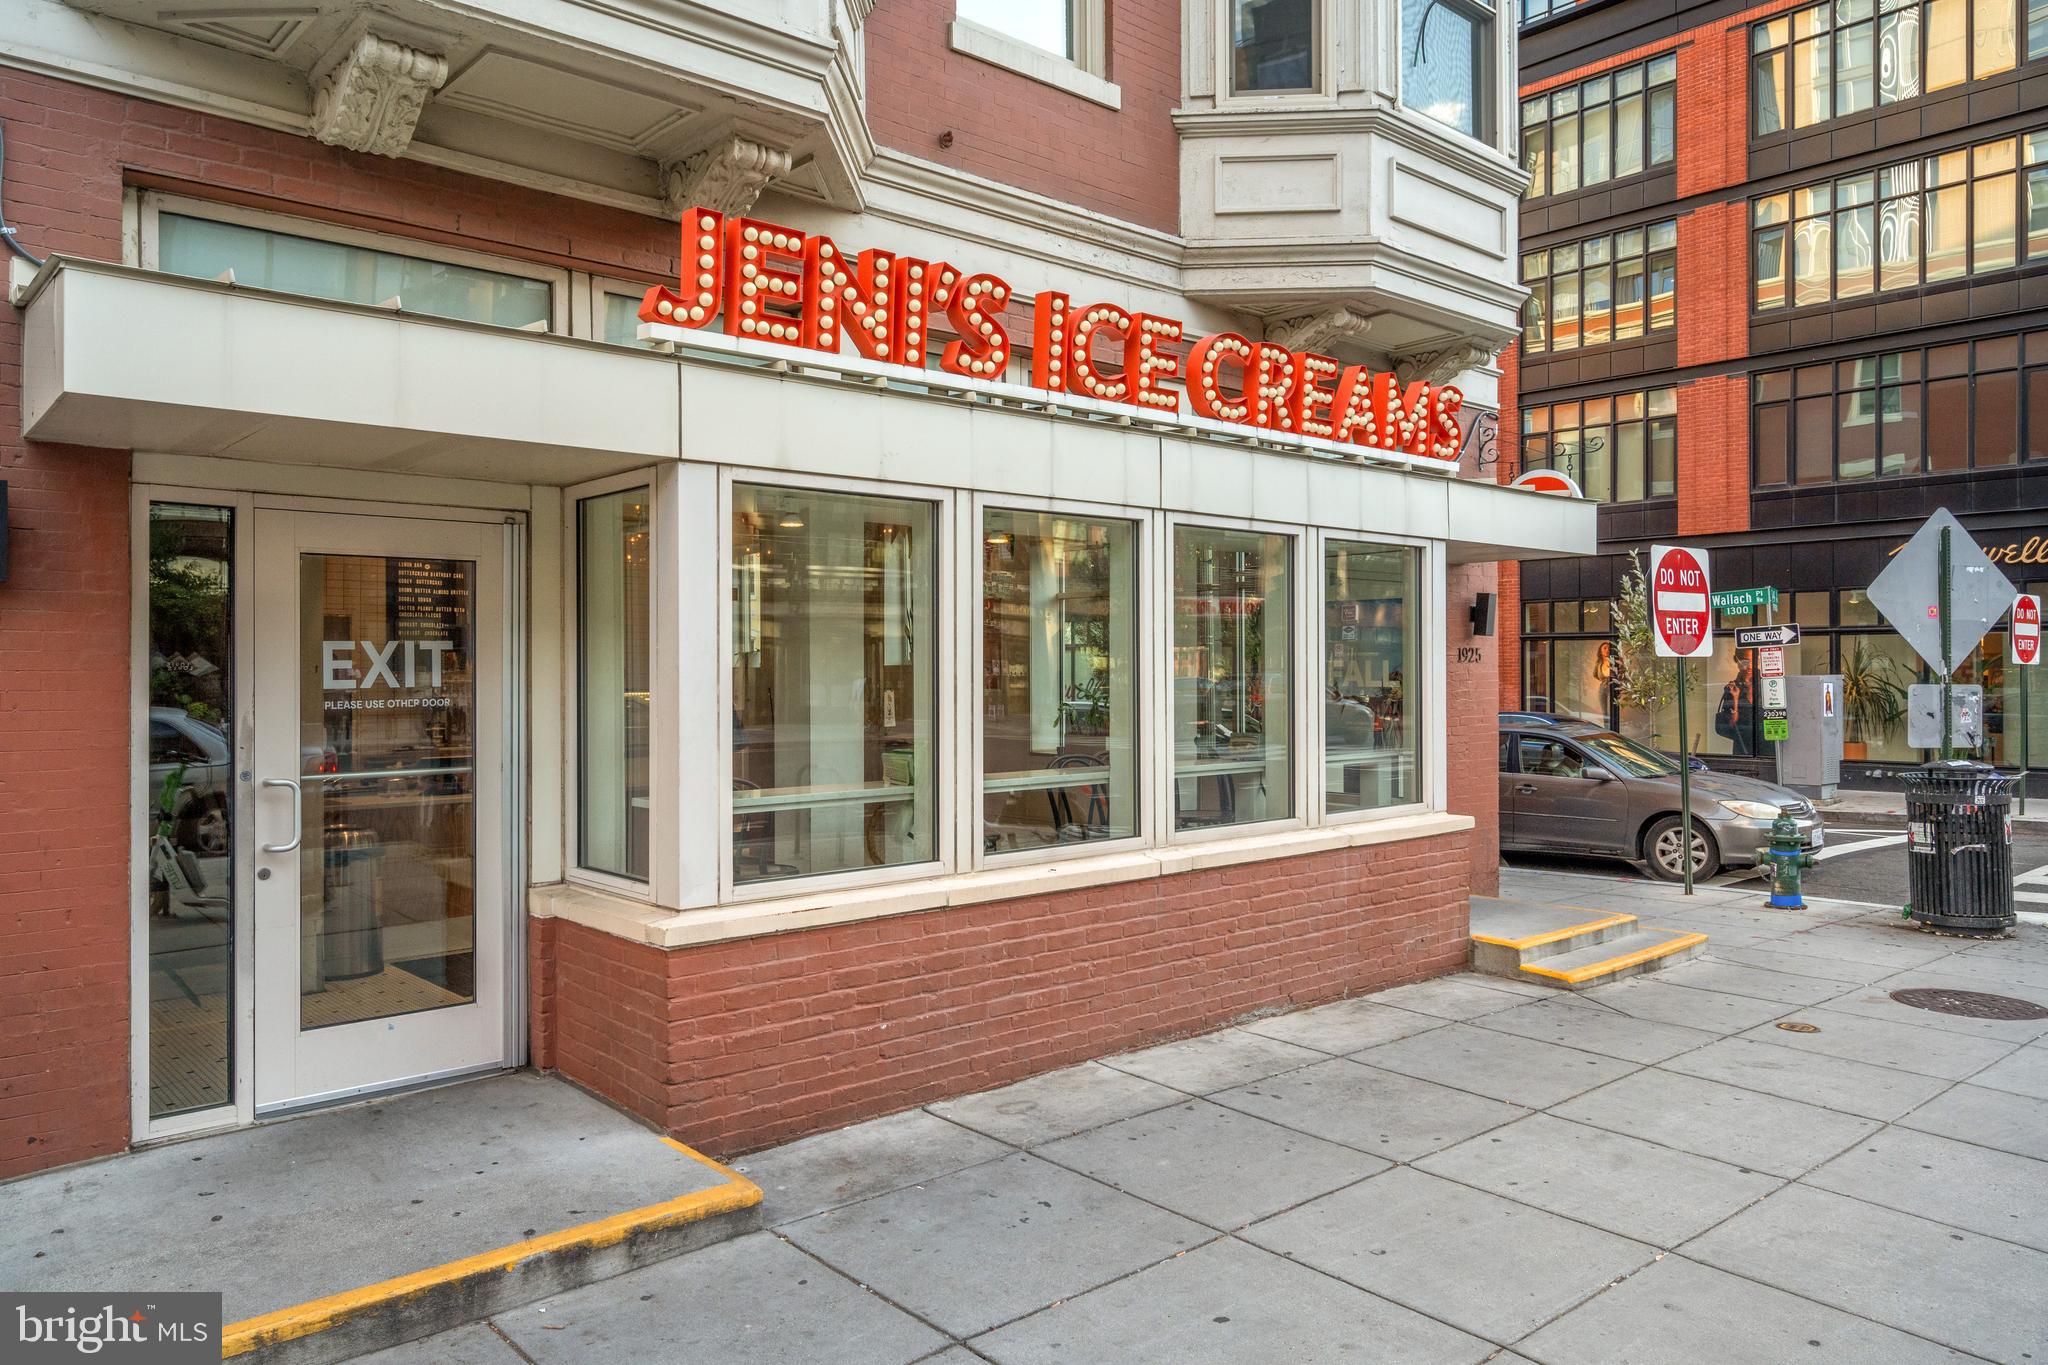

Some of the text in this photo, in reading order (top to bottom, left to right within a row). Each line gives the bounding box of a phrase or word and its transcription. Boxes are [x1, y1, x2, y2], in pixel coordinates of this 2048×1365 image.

[637, 206, 1465, 462] JENI'S ICE CREAMS
[1660, 569, 1700, 587] DO NOT
[1711, 592, 1752, 606] Wallach
[1727, 606, 1749, 615] 1300
[2016, 608, 2037, 620] DO NOT
[1666, 618, 1699, 635] ENTER
[1743, 631, 1782, 642] ONE WAY
[2018, 640, 2035, 650] ENTER
[1457, 647, 1481, 663] 1925
[322, 640, 454, 690] EXIT
[324, 698, 450, 710] PLEASE USE OTHER DOOR
